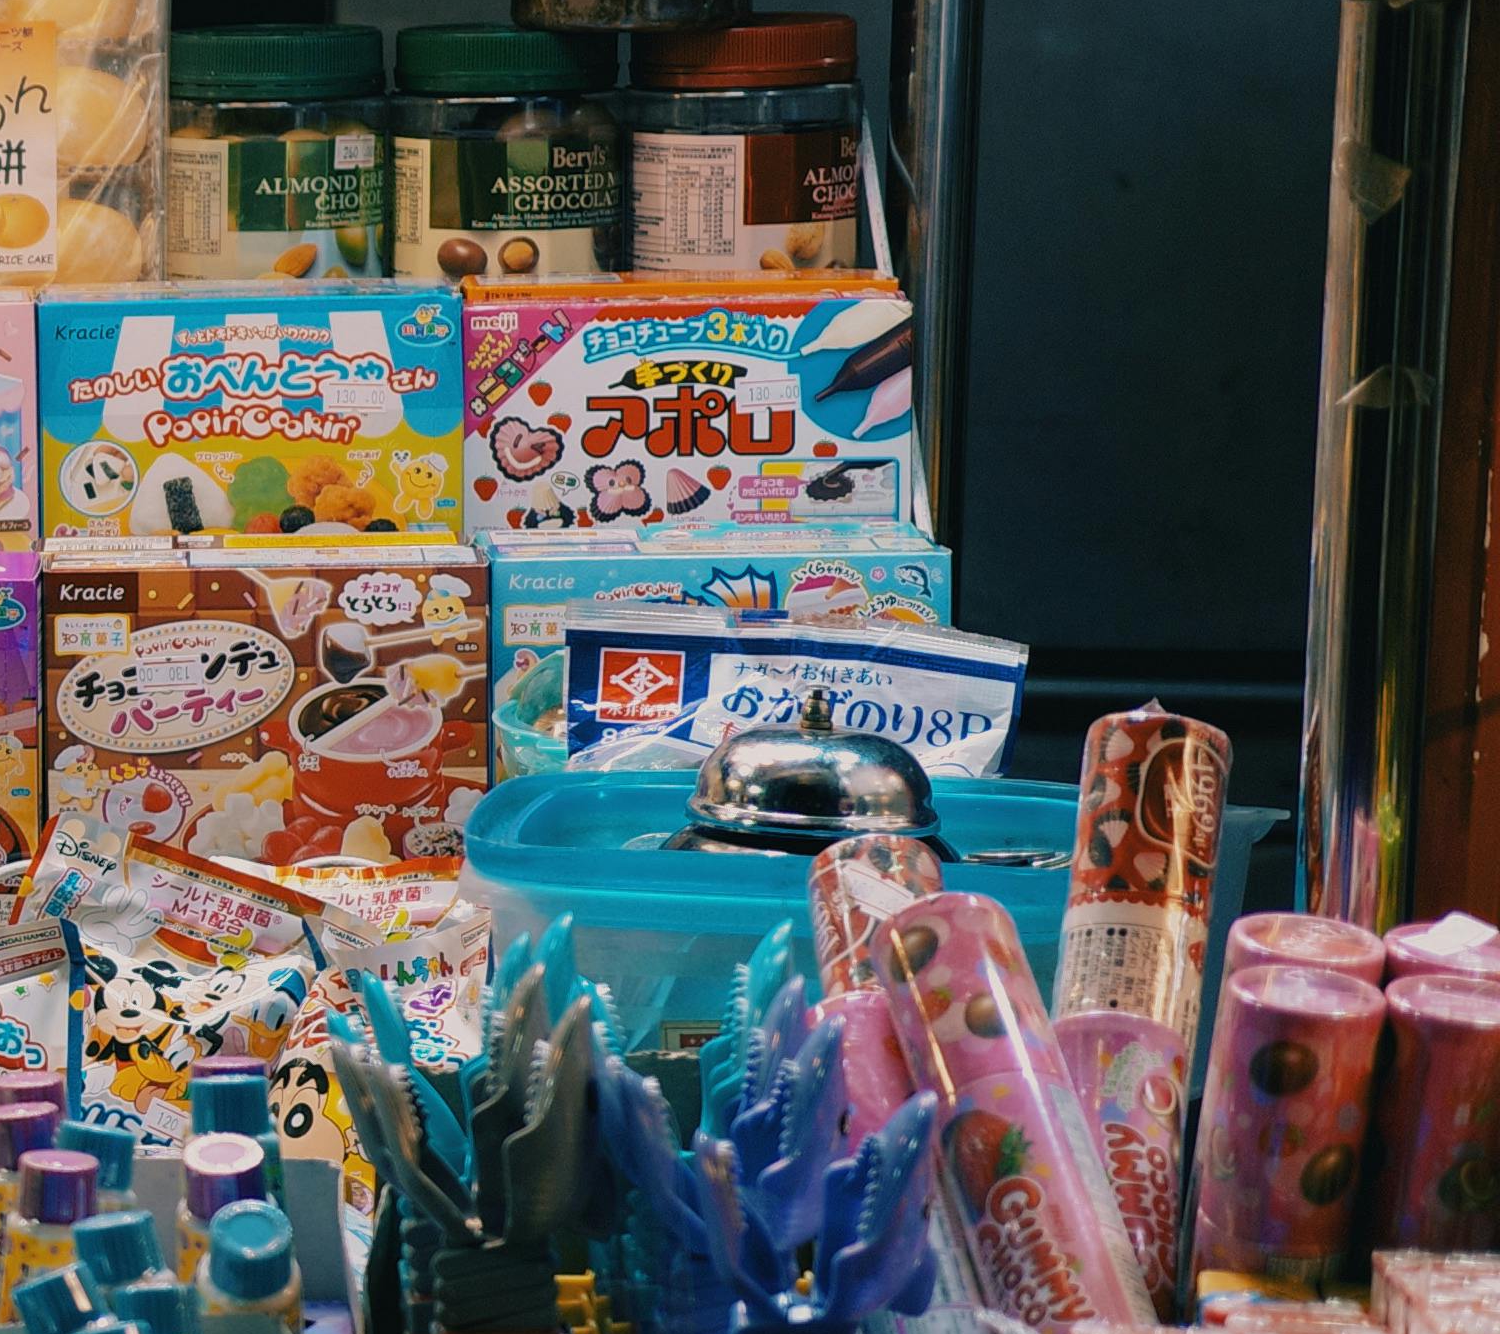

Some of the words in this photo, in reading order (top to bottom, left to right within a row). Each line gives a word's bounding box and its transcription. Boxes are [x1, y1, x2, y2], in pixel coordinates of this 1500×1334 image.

[552, 145, 608, 175] Beryl's
[255, 175, 358, 198] ALMOND
[490, 173, 604, 195] ASSORTED
[28, 253, 54, 265] CAKE
[470, 312, 519, 332] meiji
[54, 324, 120, 341] Kracie
[635, 359, 734, 387] 手づくり
[348, 451, 380, 460] からあげ
[509, 573, 576, 590] Kracie
[59, 584, 125, 601] Kracie
